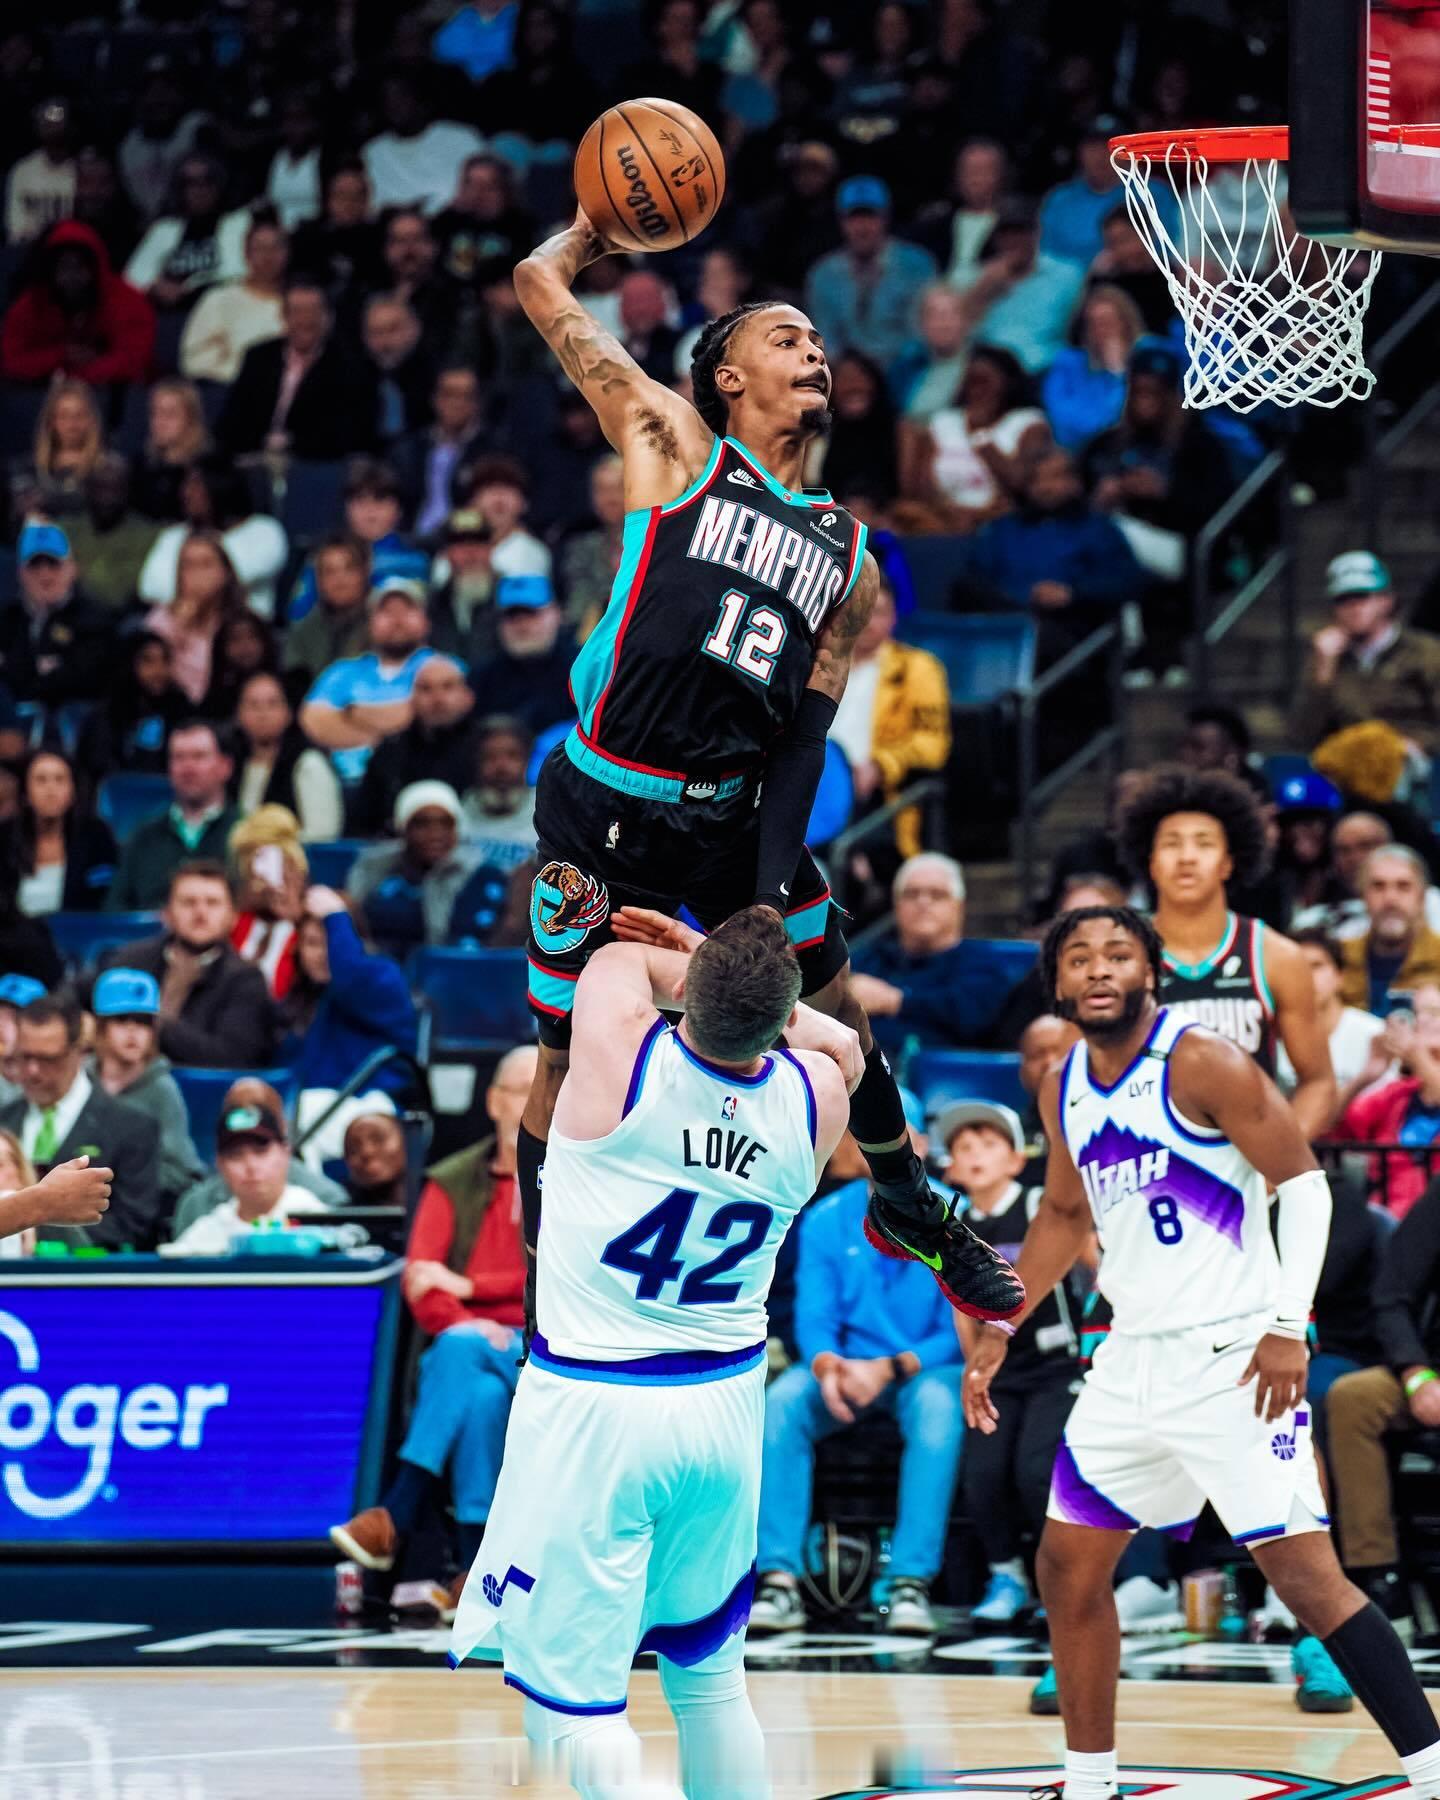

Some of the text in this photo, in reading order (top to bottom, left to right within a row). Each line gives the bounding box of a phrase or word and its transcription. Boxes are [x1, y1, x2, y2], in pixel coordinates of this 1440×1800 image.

[617, 143, 671, 237] Wilson
[733, 468, 757, 486] NIKE
[686, 494, 845, 634] MEMPHIS
[809, 520, 845, 549] Robinhood
[701, 588, 788, 686] 12
[683, 1127, 768, 1179] LOVE
[1079, 1147, 1170, 1231] UTAH
[600, 1187, 774, 1305] 42
[1149, 1195, 1183, 1245] 8
[0, 1309, 229, 1520] oger
